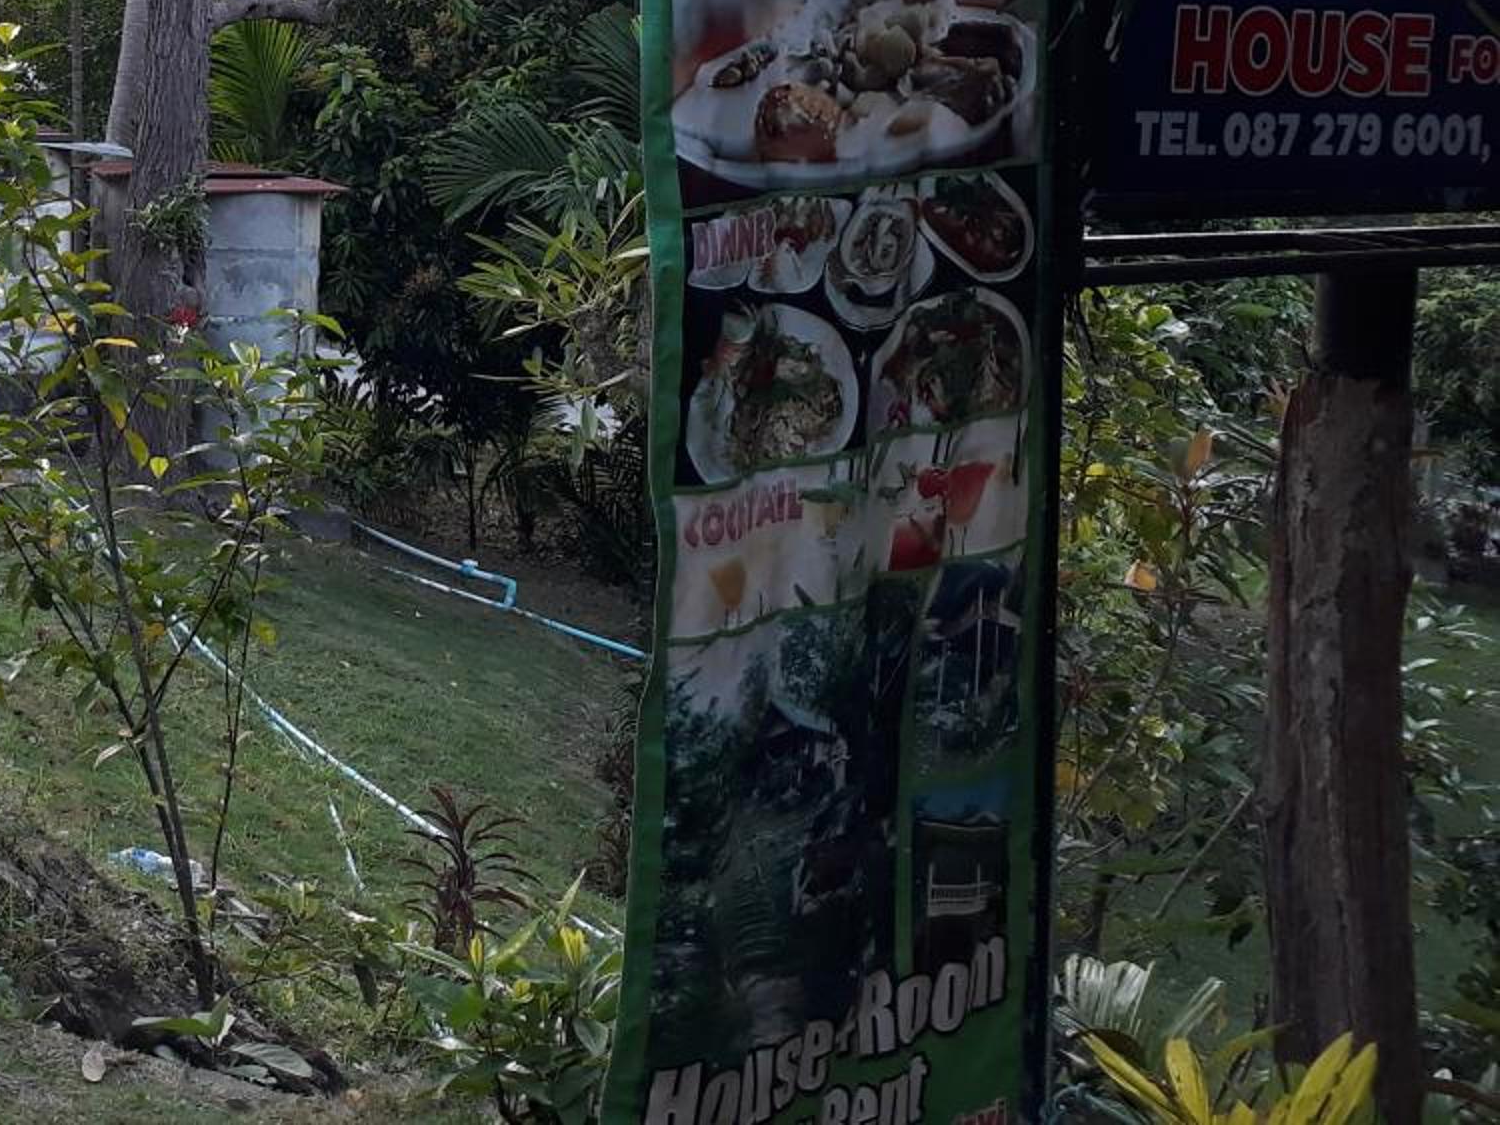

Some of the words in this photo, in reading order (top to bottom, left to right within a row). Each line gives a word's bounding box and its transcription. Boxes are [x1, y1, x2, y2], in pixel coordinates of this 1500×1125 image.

[1171, 4, 1435, 99] HOUSE
[1135, 111, 1216, 156] TEL.
[1222, 111, 1300, 158] 087
[1308, 112, 1382, 158] 279
